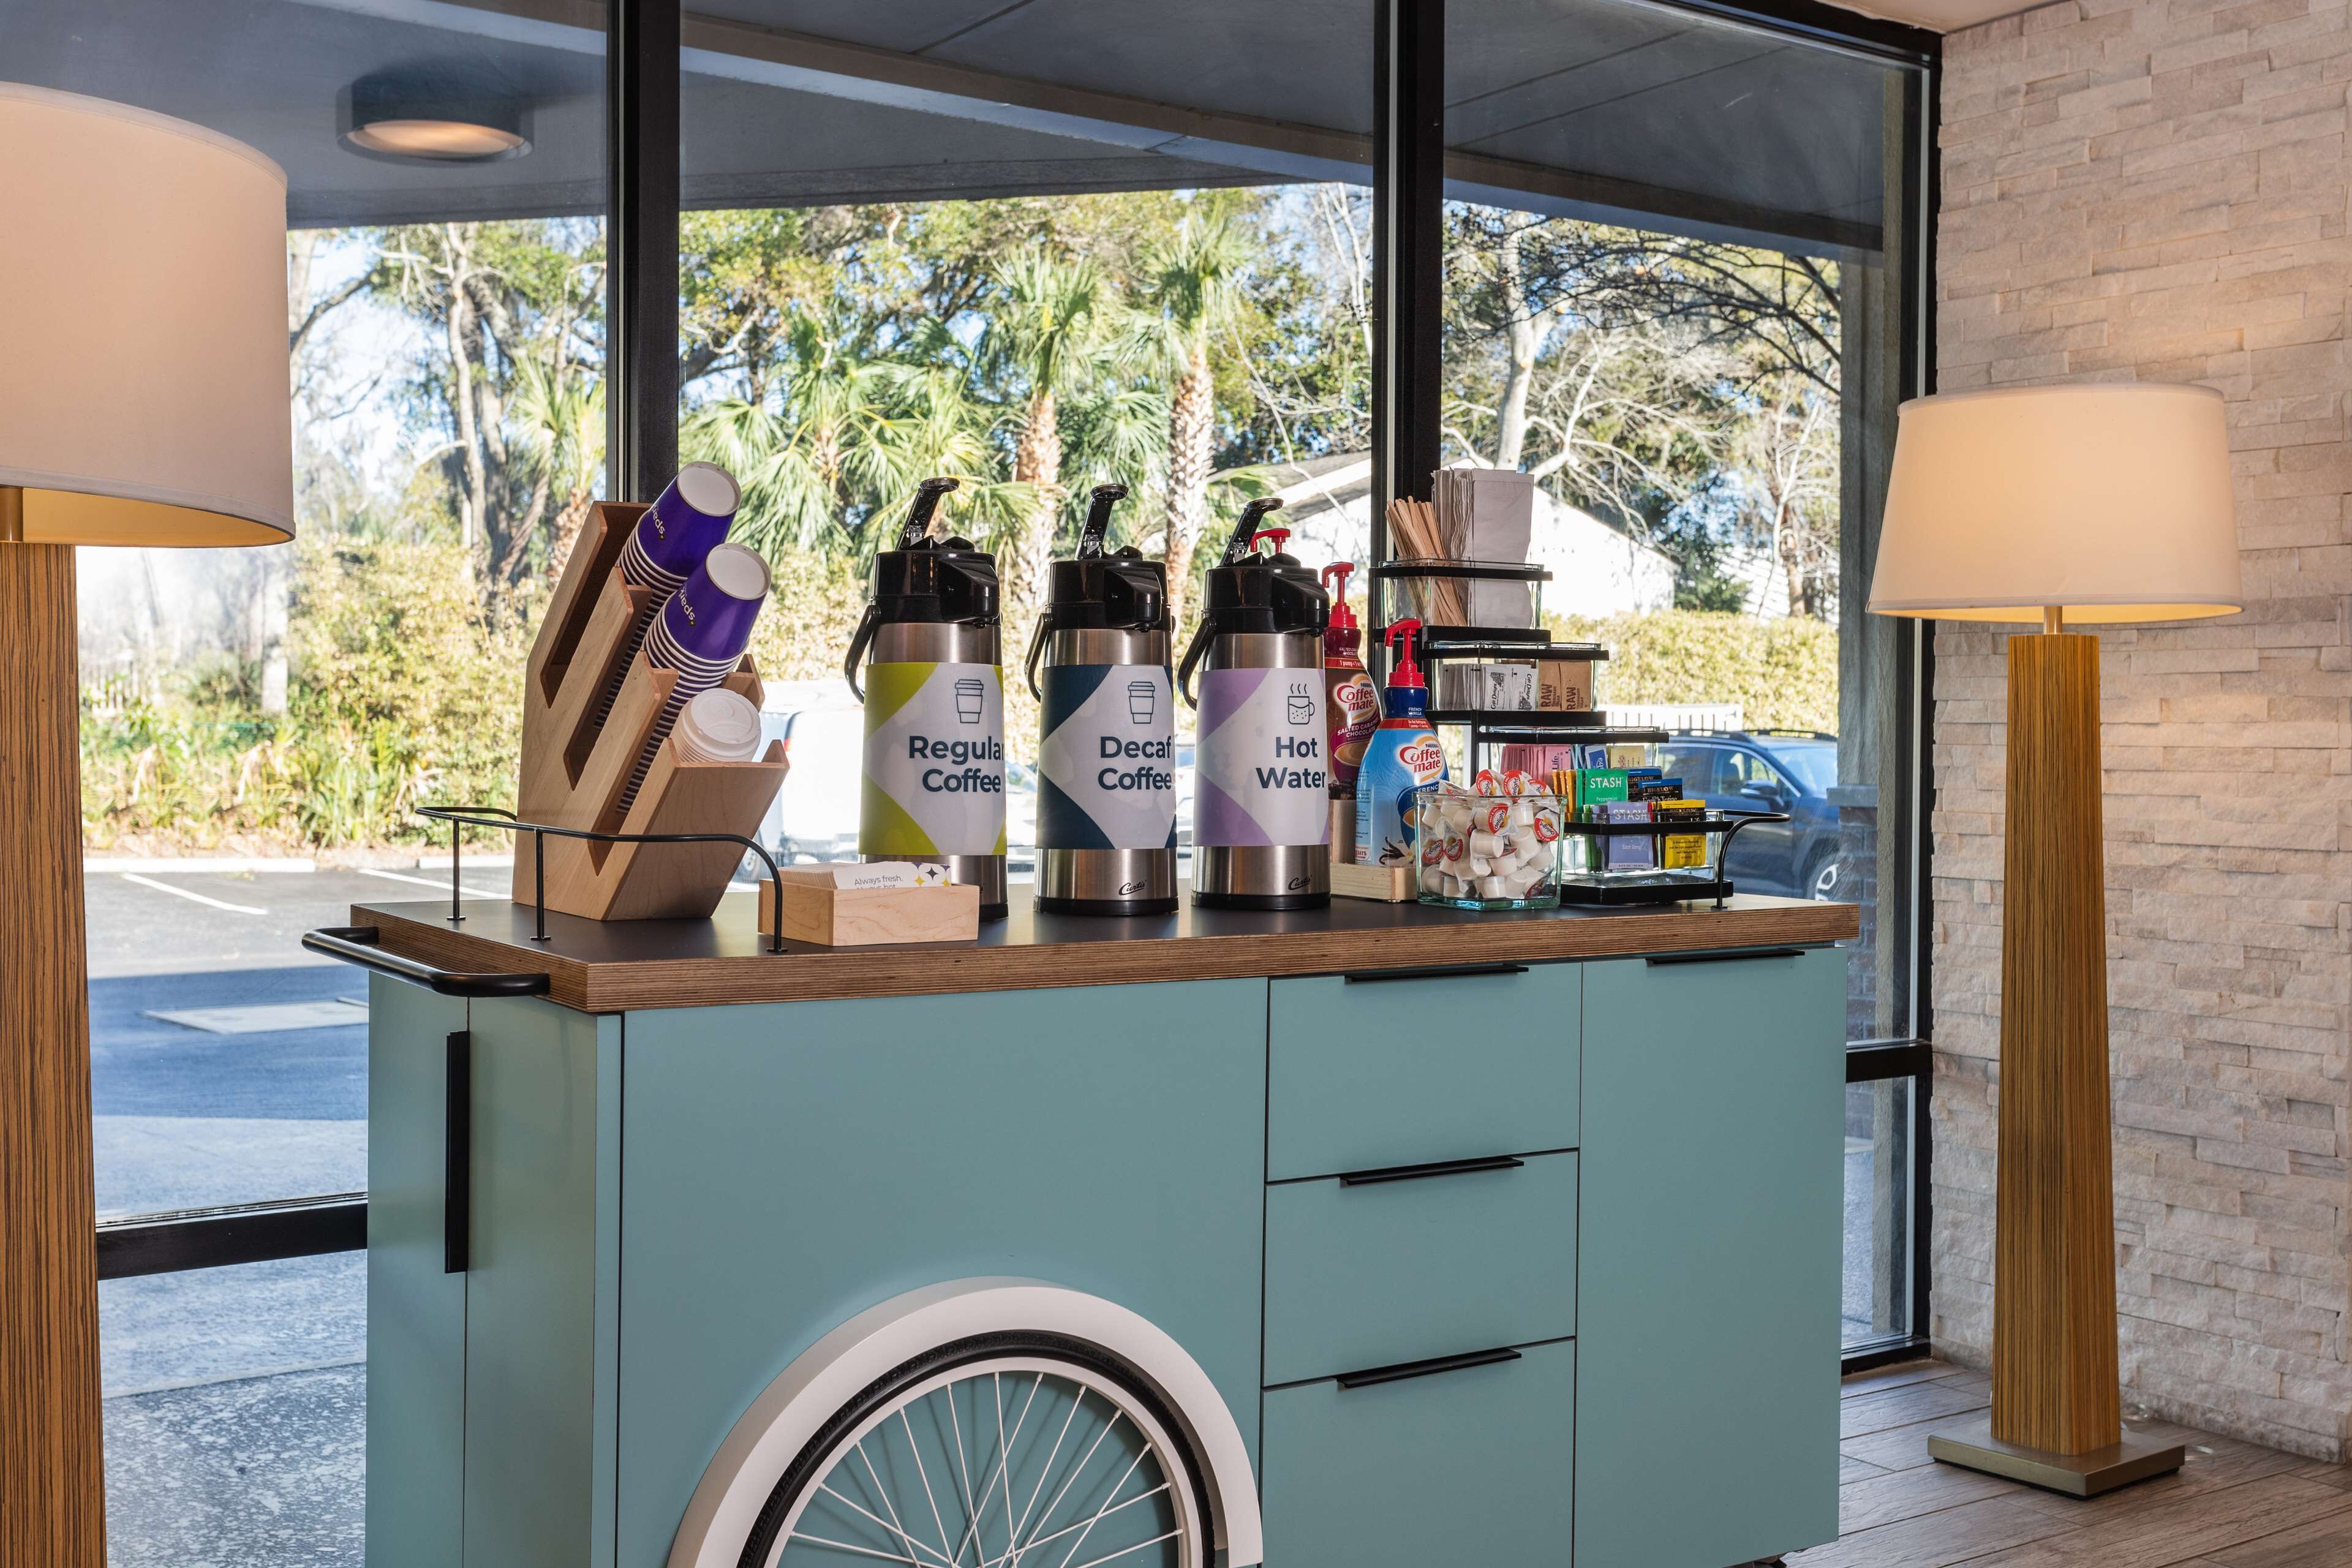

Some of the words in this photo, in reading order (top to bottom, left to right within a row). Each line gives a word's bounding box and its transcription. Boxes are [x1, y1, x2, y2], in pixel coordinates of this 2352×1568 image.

[1336, 685, 1373, 703] Coffee
[1541, 684, 1552, 707] RAW
[1566, 687, 1576, 710] RAW
[1348, 699, 1373, 711] mate
[1337, 725, 1359, 736] SALTED
[1101, 736, 1171, 758] Decaf
[1276, 737, 1318, 758] Hot
[1400, 746, 1441, 764] Coffee
[1414, 759, 1441, 773] mate
[922, 768, 1001, 793] Coffee
[1098, 767, 1172, 790] Coffee
[1256, 767, 1325, 788] Water
[1590, 777, 1622, 789] STASH
[1418, 785, 1438, 793] FRENC
[1494, 810, 1505, 829] delight
[1613, 810, 1647, 820] STASH
[1540, 821, 1555, 835] delight
[854, 877, 881, 886] Always
[1118, 881, 1145, 895] Curtis
[1288, 876, 1311, 890] Curtis
